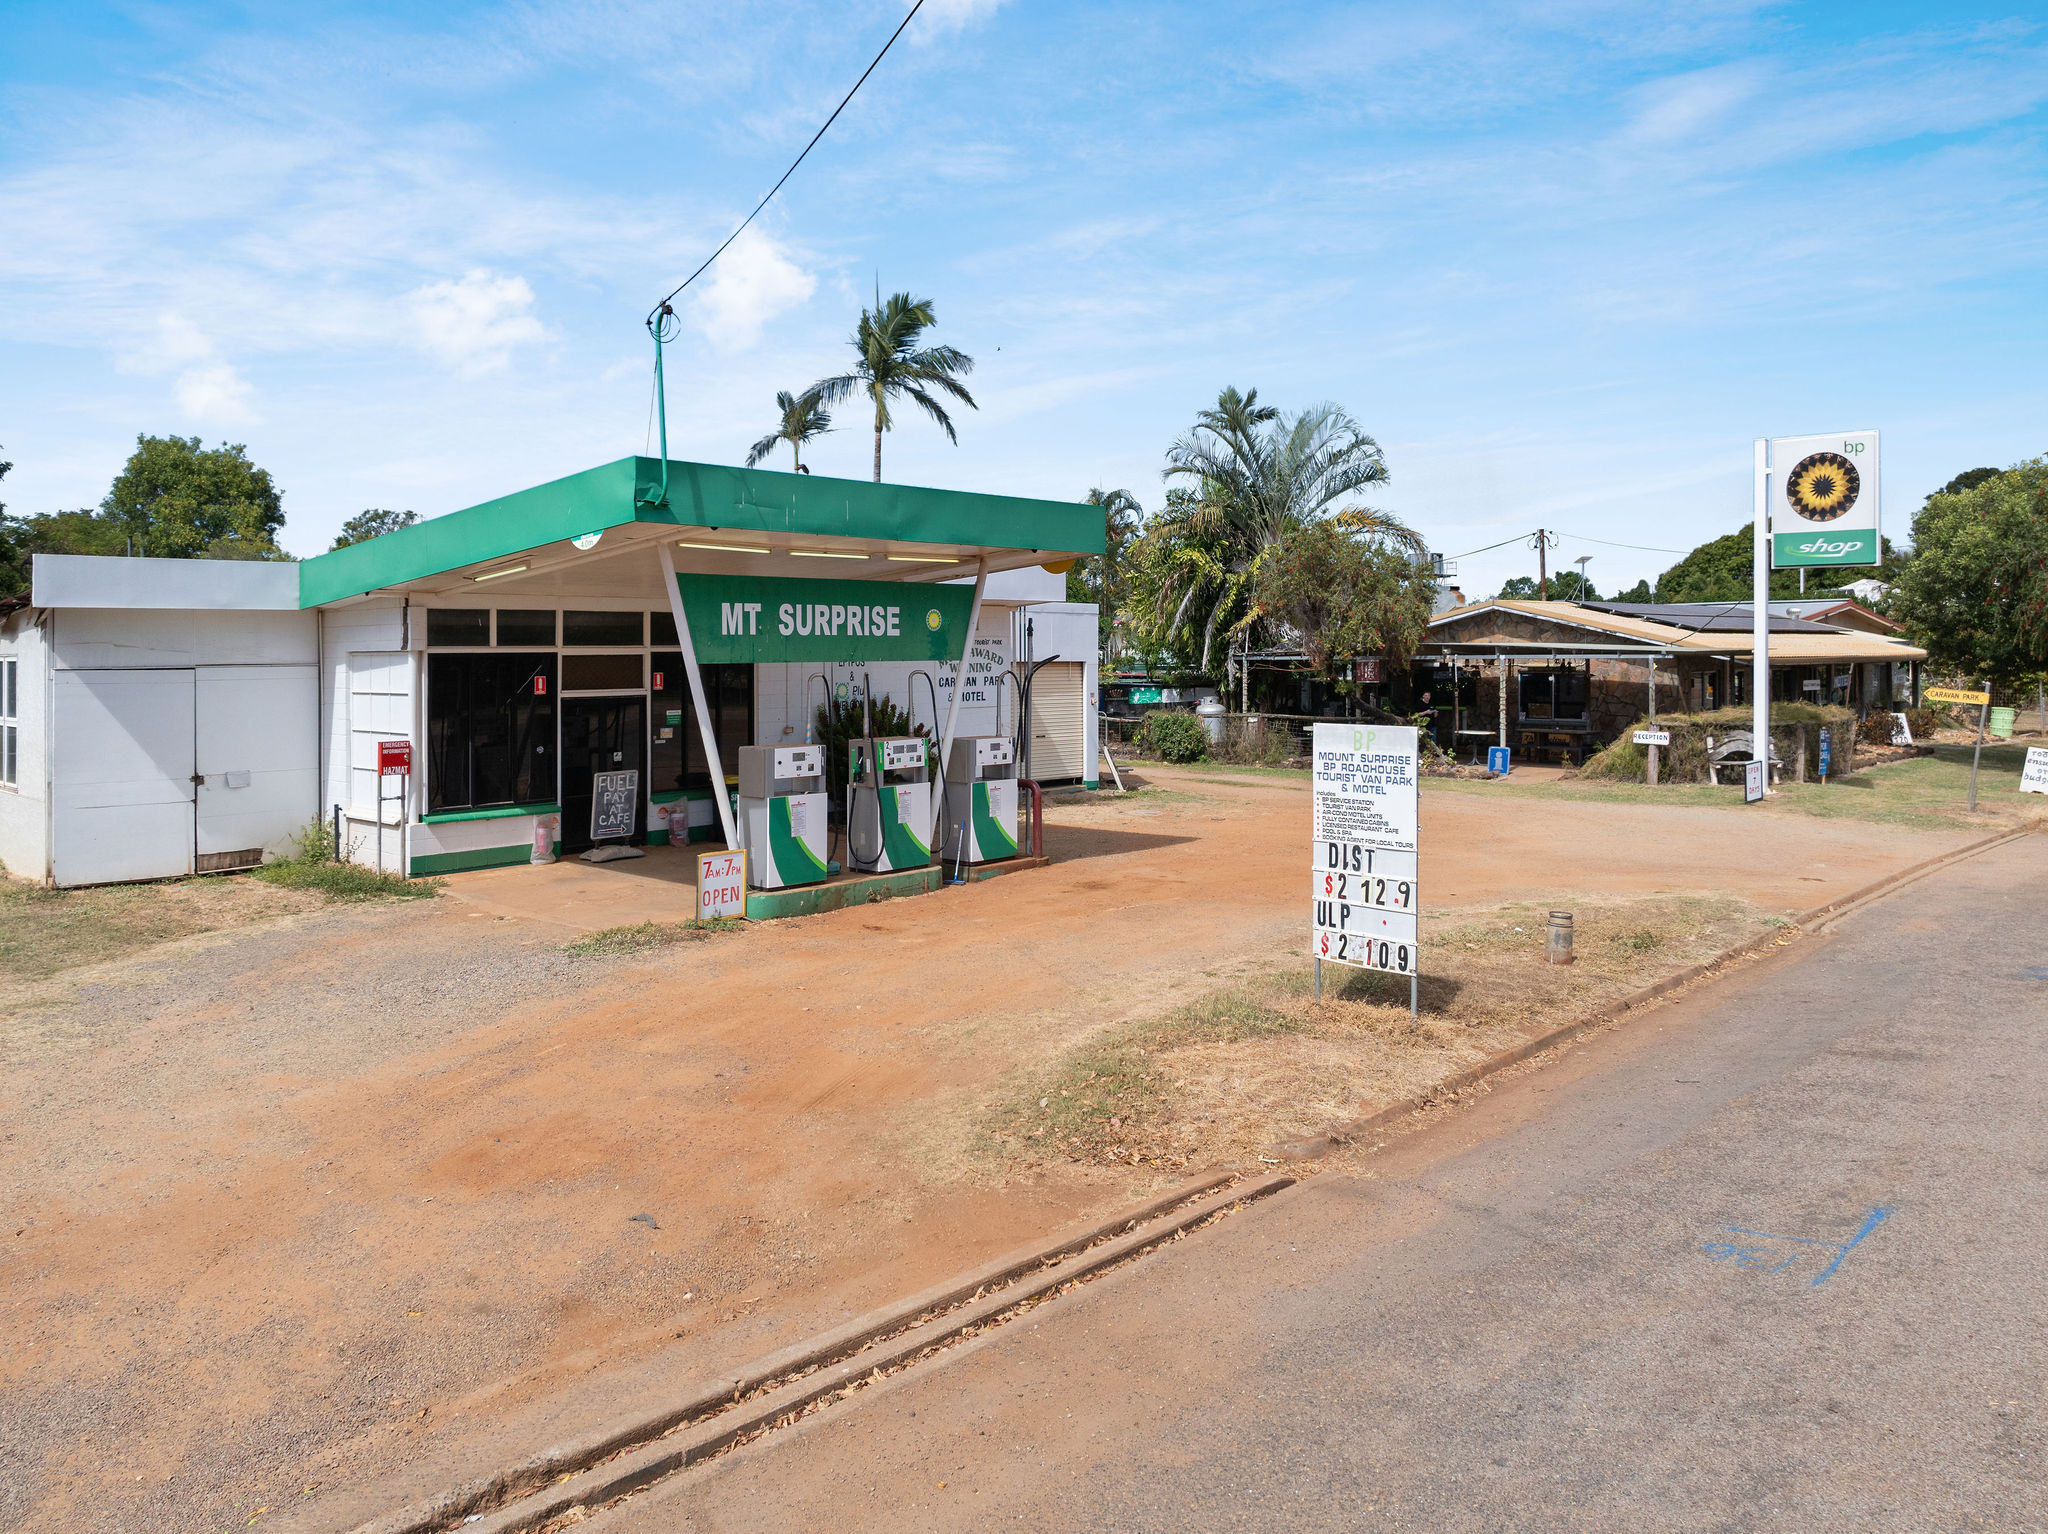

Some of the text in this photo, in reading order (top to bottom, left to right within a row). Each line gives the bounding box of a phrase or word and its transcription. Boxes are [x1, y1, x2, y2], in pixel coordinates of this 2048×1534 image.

[1844, 441, 1865, 456] bp
[1799, 538, 1863, 556] shop
[721, 602, 900, 636] MT SURPRISE
[949, 662, 992, 673] WNING
[850, 671, 854, 681] &
[939, 677, 977, 687] CARAN
[1930, 690, 1960, 699] CARAVAN
[1353, 730, 1376, 752] BP
[1634, 733, 1668, 741] RECEPTION
[1318, 752, 1411, 765] MOUNT SURPRISE
[383, 766, 408, 775] HAZMAT
[1324, 762, 1406, 775] BP ROADHOUSE
[598, 774, 635, 792] FUEL
[1317, 772, 1413, 786] TOURIST VAN PARK
[1342, 783, 1387, 795] & MOTEL
[604, 792, 628, 804] PAY
[610, 804, 624, 814] AT
[599, 813, 630, 825] CAFE
[1338, 817, 1368, 825] CONTAINED
[1348, 824, 1382, 832] RESTAURANT
[702, 886, 740, 907] OPEN
[1318, 901, 1350, 929] ULP
